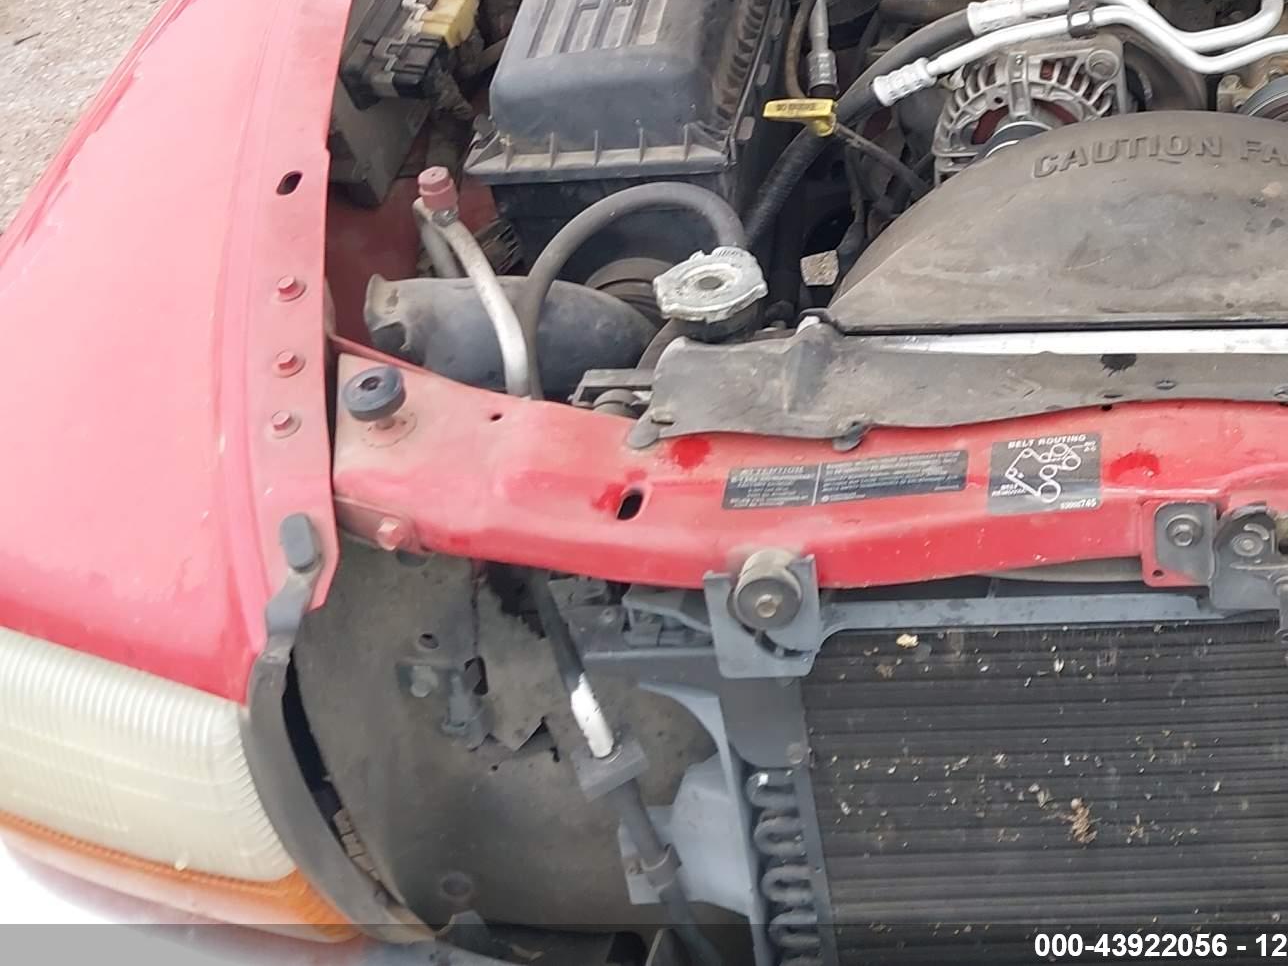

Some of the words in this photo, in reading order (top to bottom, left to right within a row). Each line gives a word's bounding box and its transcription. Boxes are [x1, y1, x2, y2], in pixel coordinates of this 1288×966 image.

[1031, 134, 1223, 178] CAUTION
[1007, 439, 1034, 450] BELT
[1038, 434, 1087, 446] ROUTING
